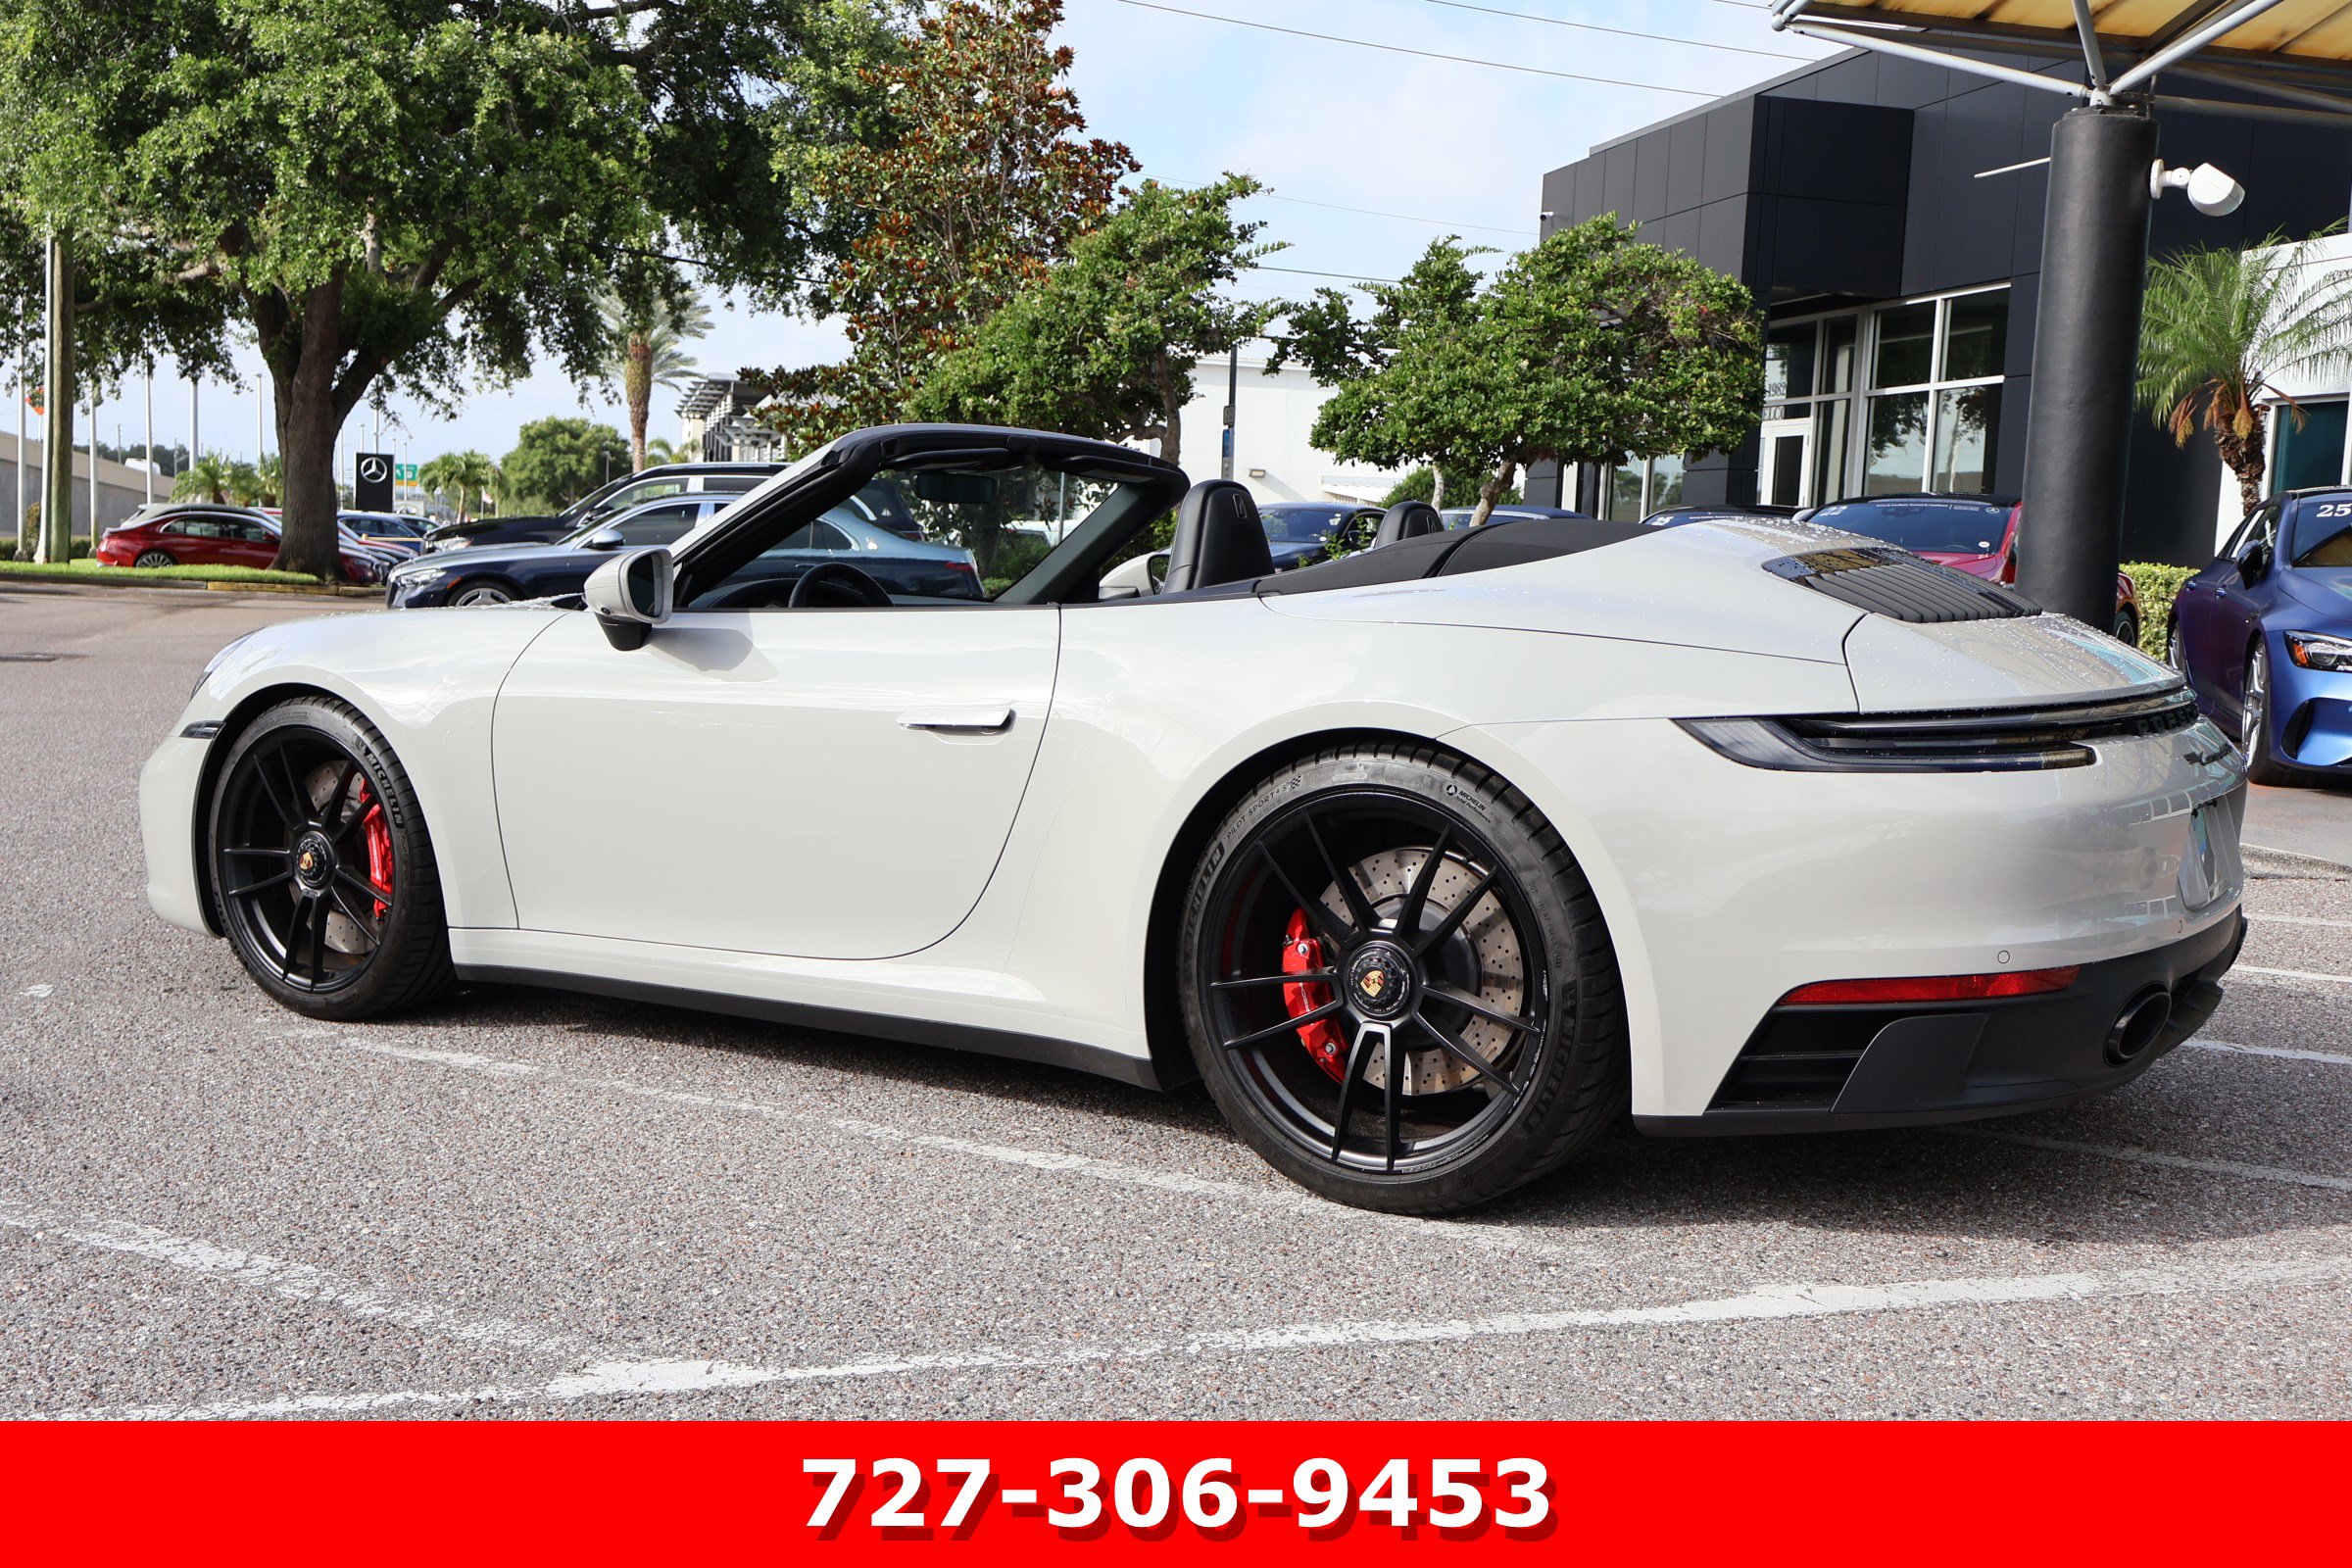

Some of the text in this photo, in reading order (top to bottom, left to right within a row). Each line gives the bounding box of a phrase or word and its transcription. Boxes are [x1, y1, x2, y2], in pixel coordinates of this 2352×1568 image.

[1764, 406, 1786, 420] ELCO
[2316, 503, 2352, 517] 25
[367, 754, 404, 827] MICHELIN
[1458, 790, 1487, 811] MICHELIN
[1227, 815, 1247, 841] PILOT
[1249, 791, 1276, 816] SPORT
[1454, 795, 1492, 823] Total Performance
[370, 824, 382, 880] PORSCHE
